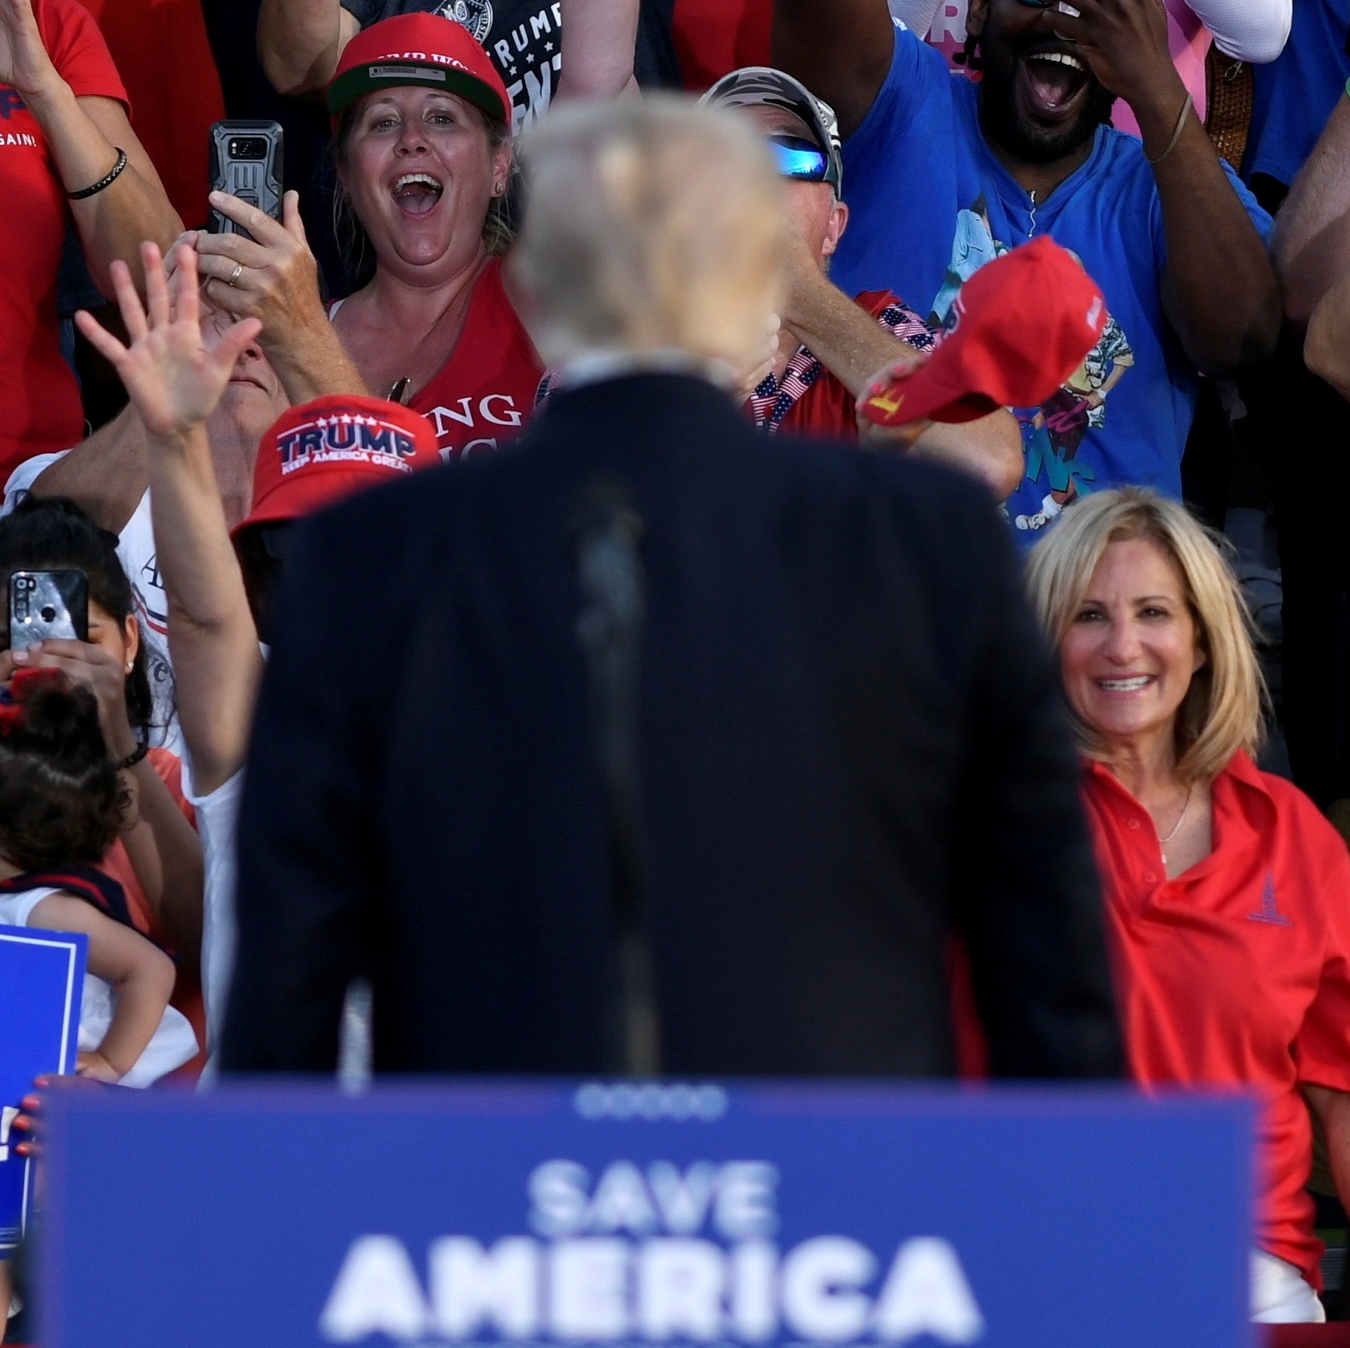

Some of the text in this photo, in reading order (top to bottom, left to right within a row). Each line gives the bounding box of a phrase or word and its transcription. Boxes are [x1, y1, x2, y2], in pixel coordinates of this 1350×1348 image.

[487, 0, 563, 70] RUMP
[277, 423, 417, 466] TRUMP
[281, 457, 311, 476] KEEP
[312, 451, 370, 464] AMERICA
[528, 1160, 781, 1238] SAVE
[319, 1234, 984, 1344] AMERICA
